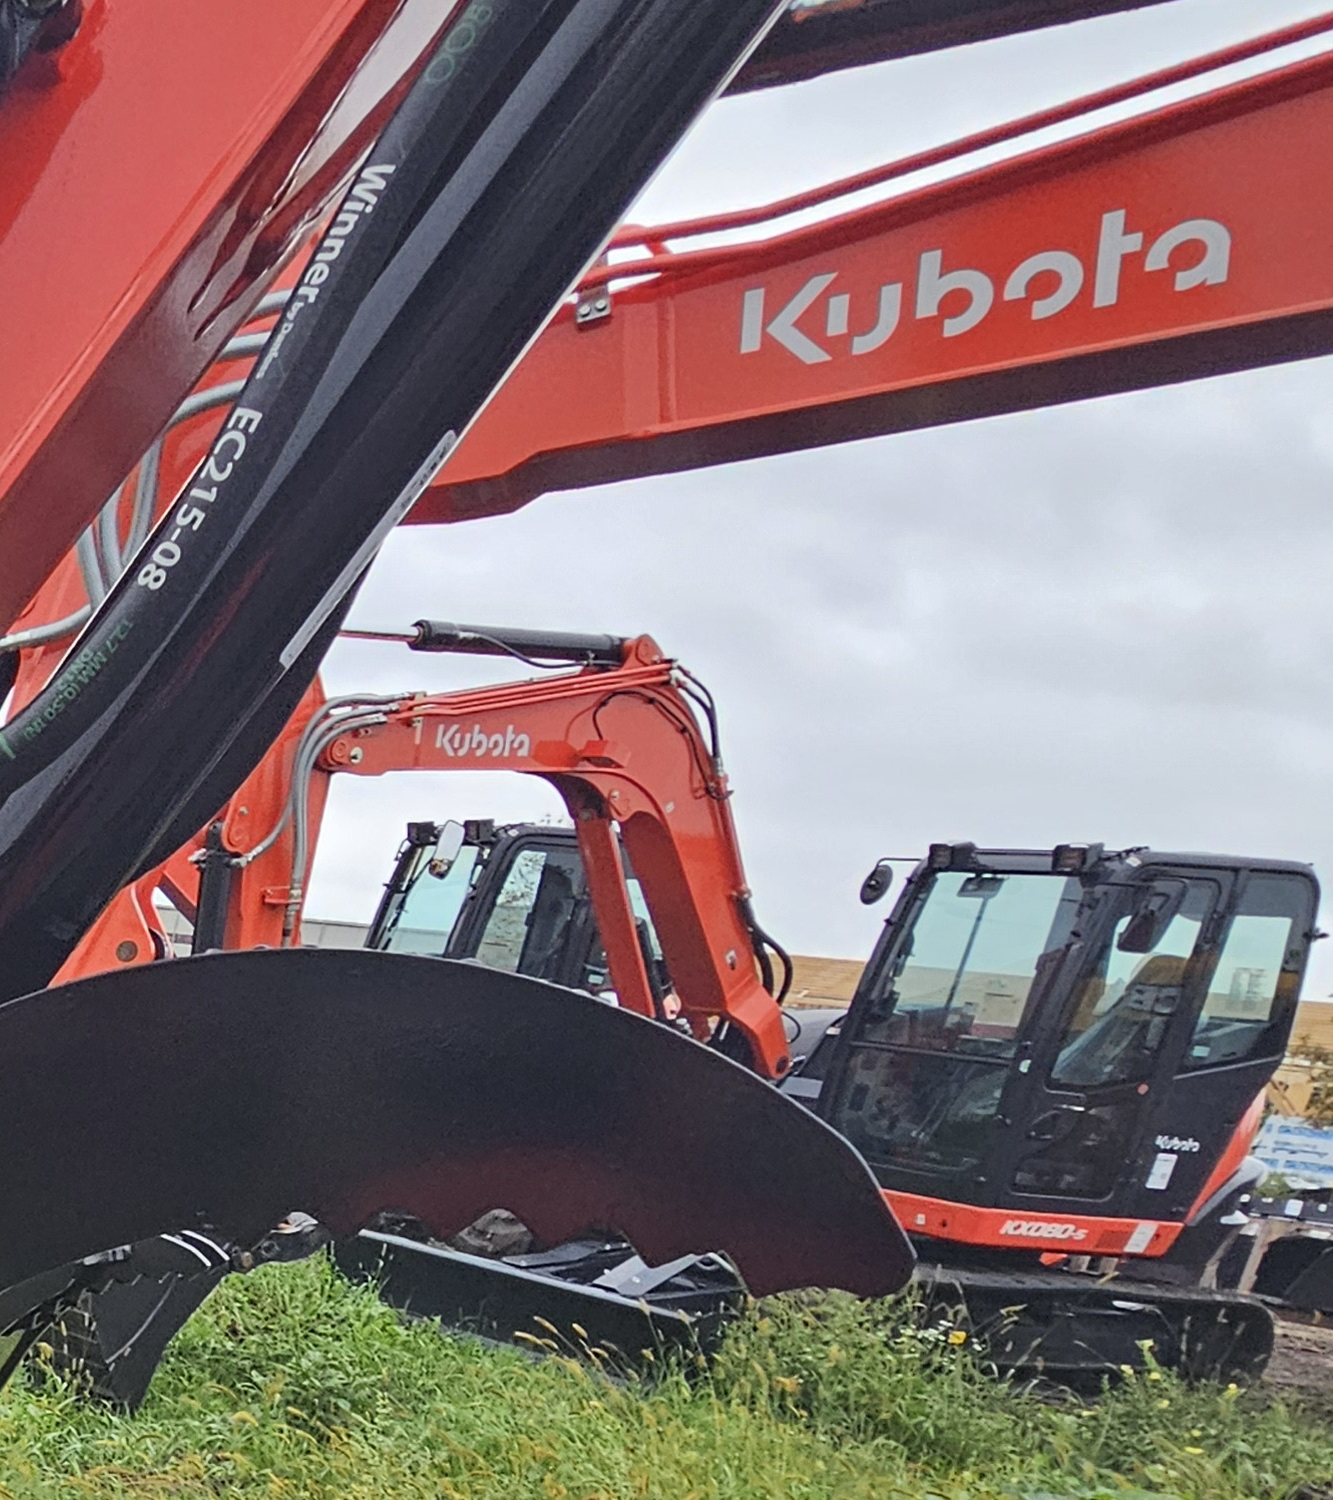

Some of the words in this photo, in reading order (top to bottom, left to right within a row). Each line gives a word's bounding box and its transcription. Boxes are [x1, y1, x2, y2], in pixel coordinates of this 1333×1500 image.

[301, 163, 396, 304] Winner
[739, 208, 1232, 365] Kubota
[137, 405, 263, 591] EC215-08
[77, 650, 107, 684] MM
[434, 723, 530, 757] Kubota
[1154, 1135, 1200, 1152] Kubota
